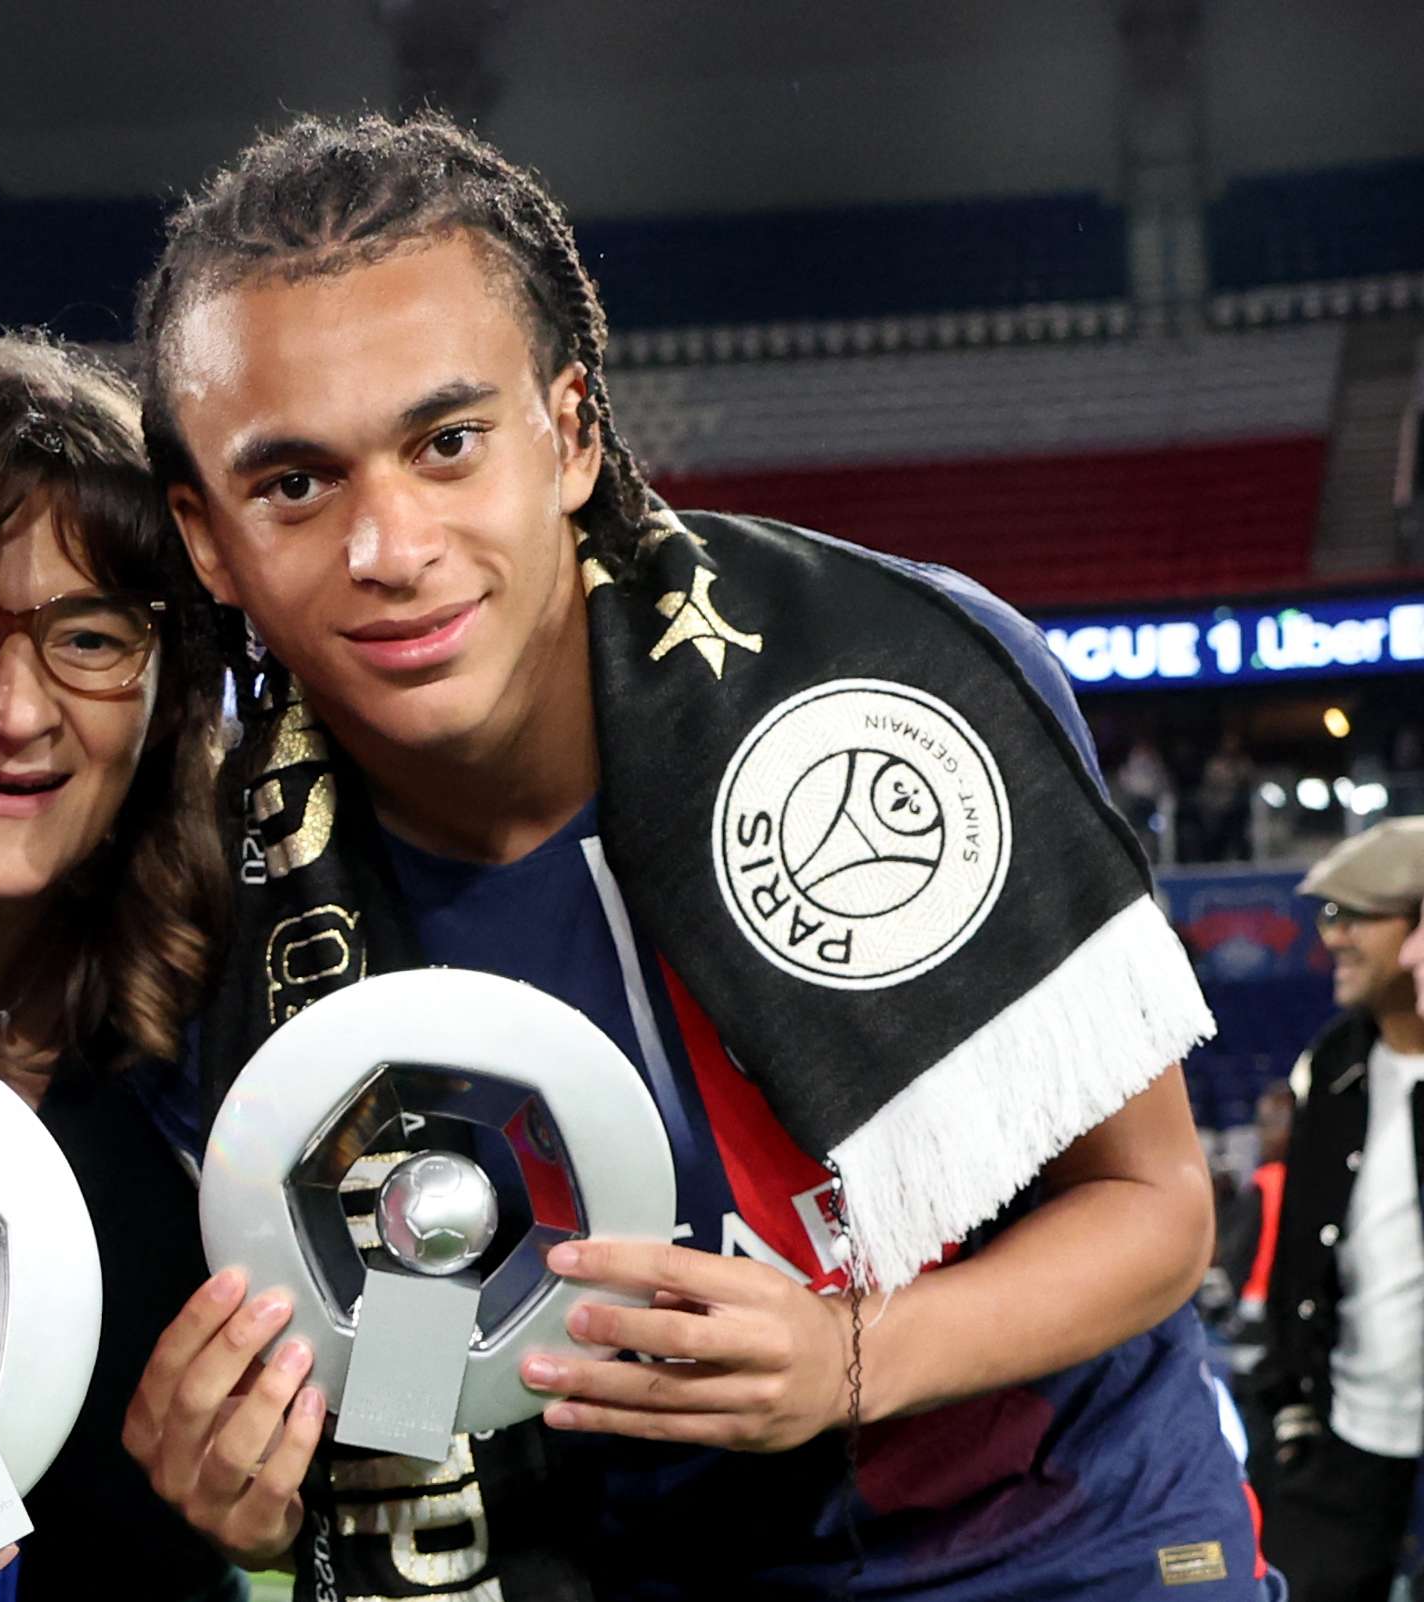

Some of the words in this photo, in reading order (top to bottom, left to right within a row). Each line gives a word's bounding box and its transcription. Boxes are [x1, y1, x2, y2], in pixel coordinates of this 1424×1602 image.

[1207, 618, 1243, 674] 1
[1256, 612, 1388, 670] Uber
[737, 811, 853, 964] PARIS
